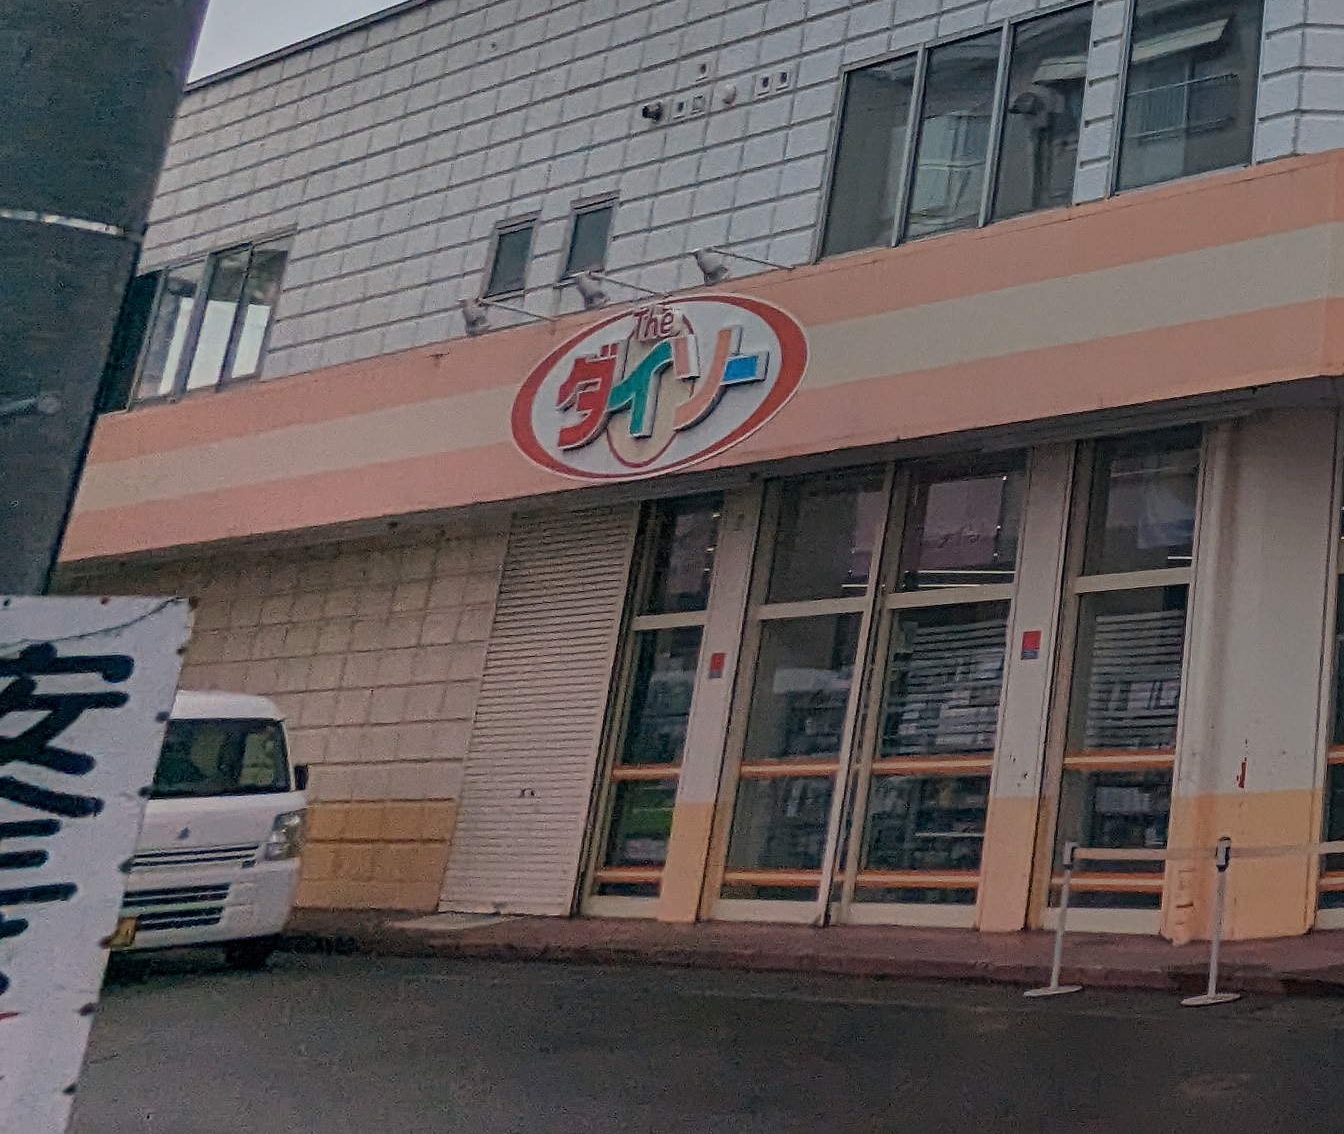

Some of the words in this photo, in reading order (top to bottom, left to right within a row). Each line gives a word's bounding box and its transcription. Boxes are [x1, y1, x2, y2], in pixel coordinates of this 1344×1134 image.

[633, 305, 675, 339] The
[556, 326, 770, 451] ダイソー
